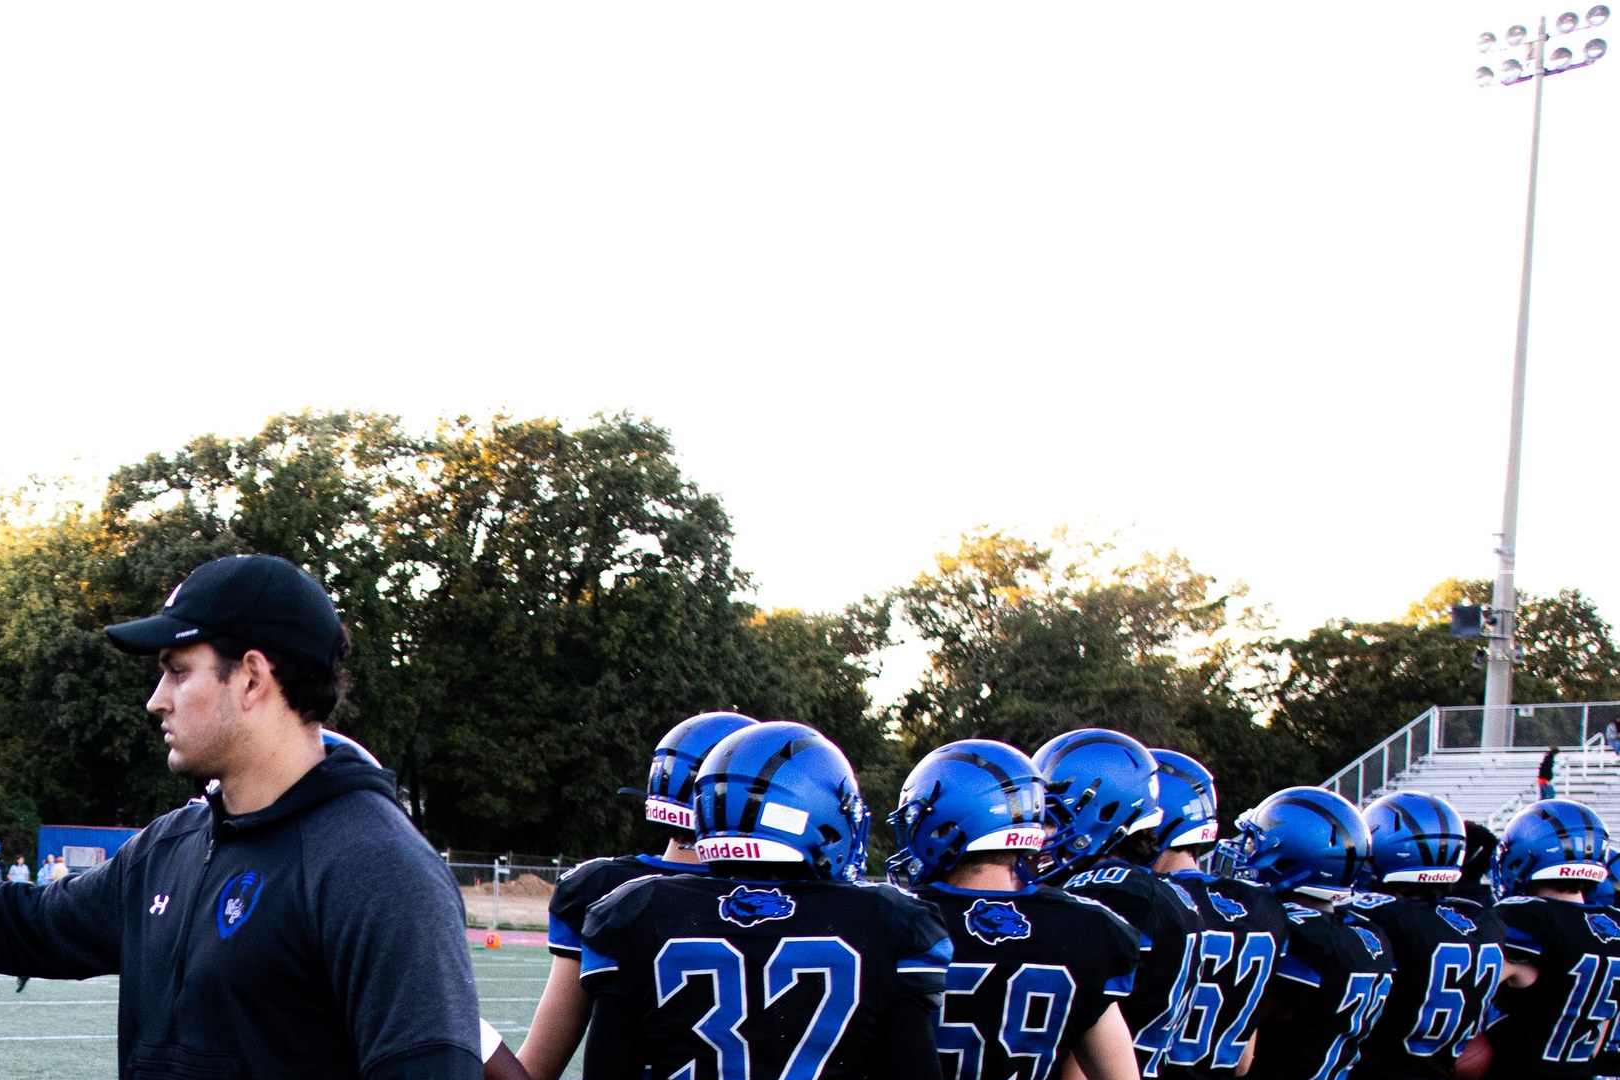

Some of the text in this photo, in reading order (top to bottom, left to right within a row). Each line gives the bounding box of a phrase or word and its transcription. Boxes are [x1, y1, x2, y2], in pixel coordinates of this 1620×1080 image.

[645, 806, 690, 827] Riddell
[1005, 833, 1044, 850] Ridde
[697, 842, 760, 860] Riddell
[1417, 873, 1457, 883] Riddell
[1559, 867, 1604, 880] Riddell
[1165, 930, 1276, 1069] 62
[1542, 953, 1620, 1062] 15
